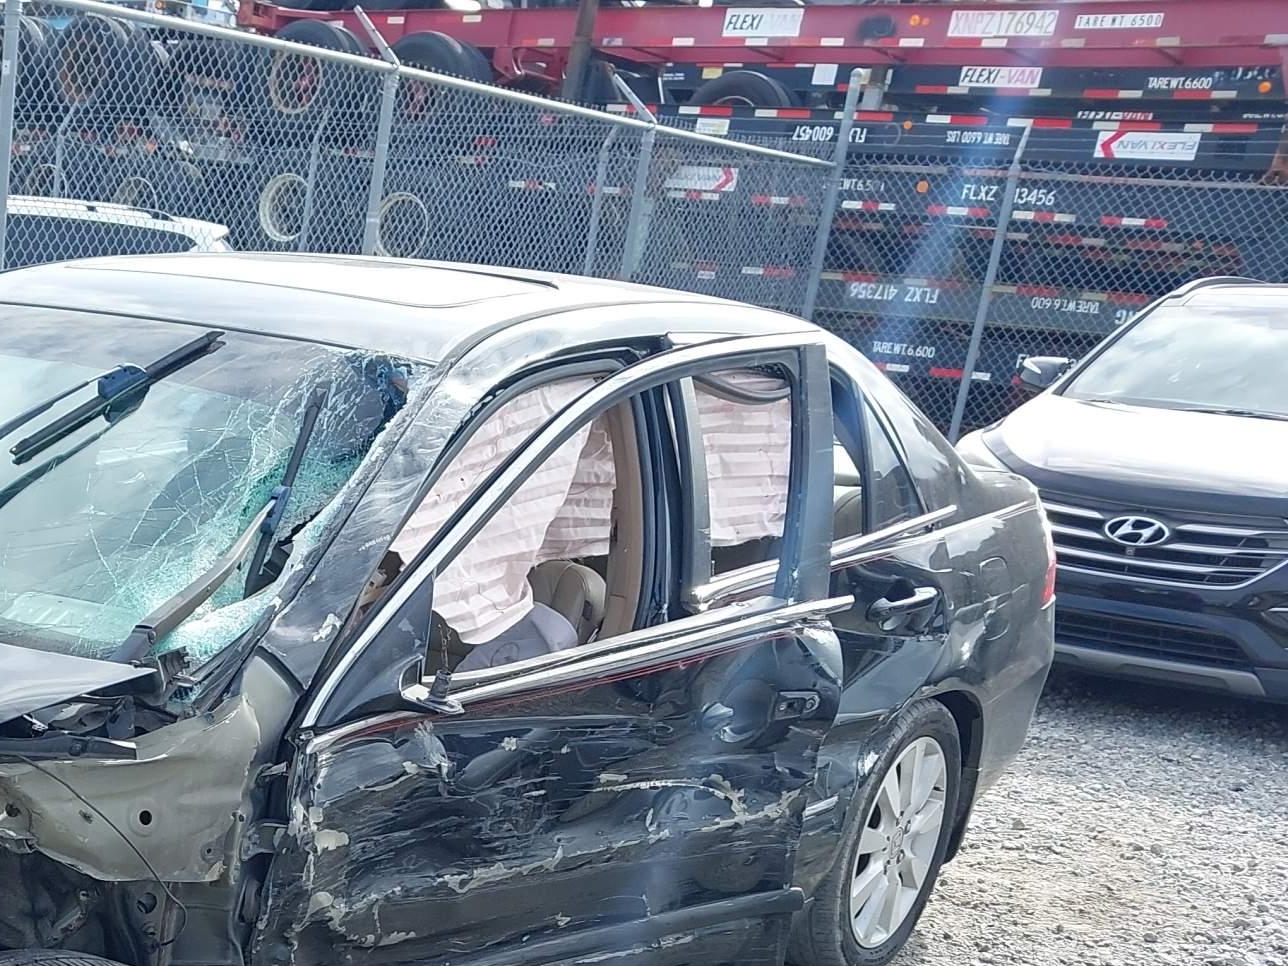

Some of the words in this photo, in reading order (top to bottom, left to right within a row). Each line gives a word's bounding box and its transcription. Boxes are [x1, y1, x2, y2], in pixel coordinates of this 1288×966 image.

[1130, 15, 1162, 26] 6500
[961, 184, 999, 202] FLXZ
[1012, 187, 1057, 206] 13456
[904, 286, 939, 304] FLXZ
